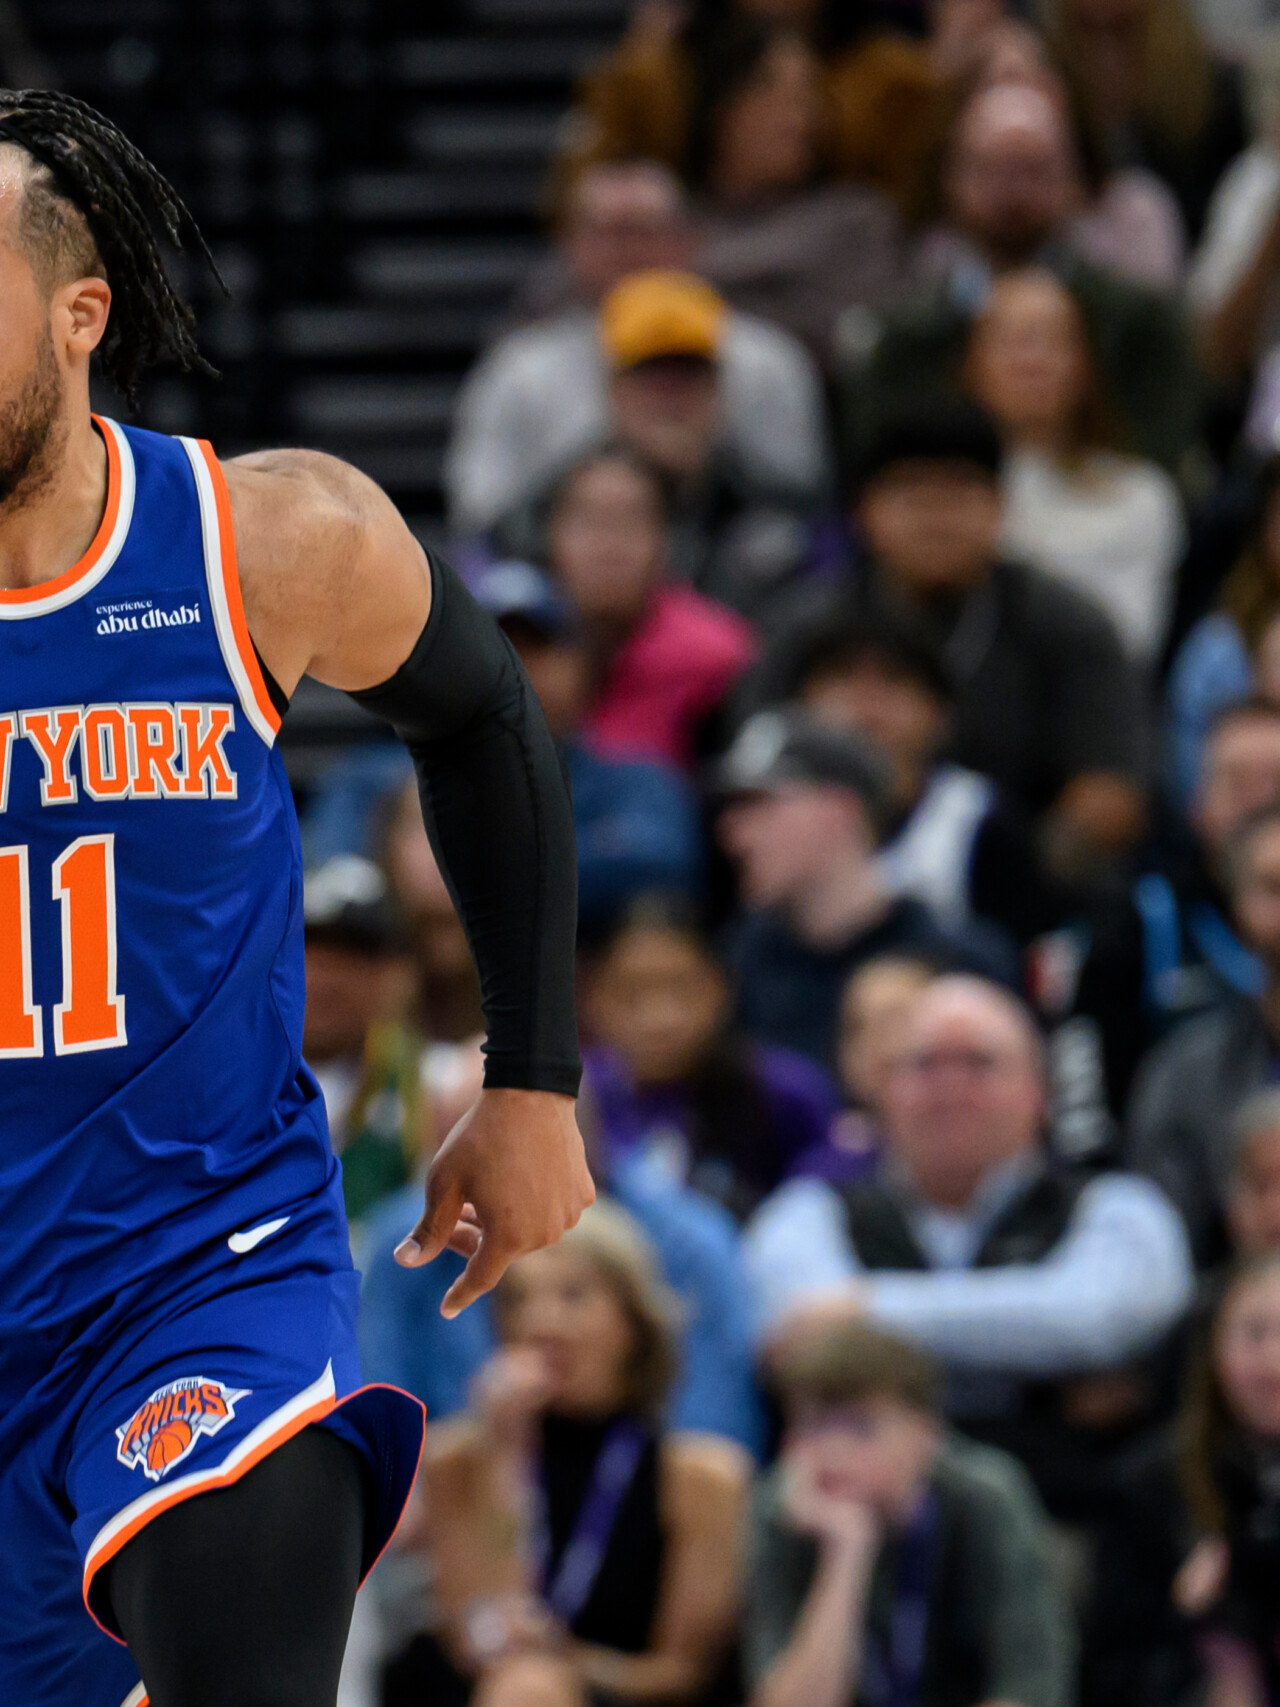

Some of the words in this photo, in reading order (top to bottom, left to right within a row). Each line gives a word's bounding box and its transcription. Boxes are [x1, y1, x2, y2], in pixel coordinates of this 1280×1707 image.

[96, 600, 153, 615] experience
[96, 614, 138, 635] abu
[17, 702, 238, 807] YORK
[121, 1384, 229, 1455] KNICKS
